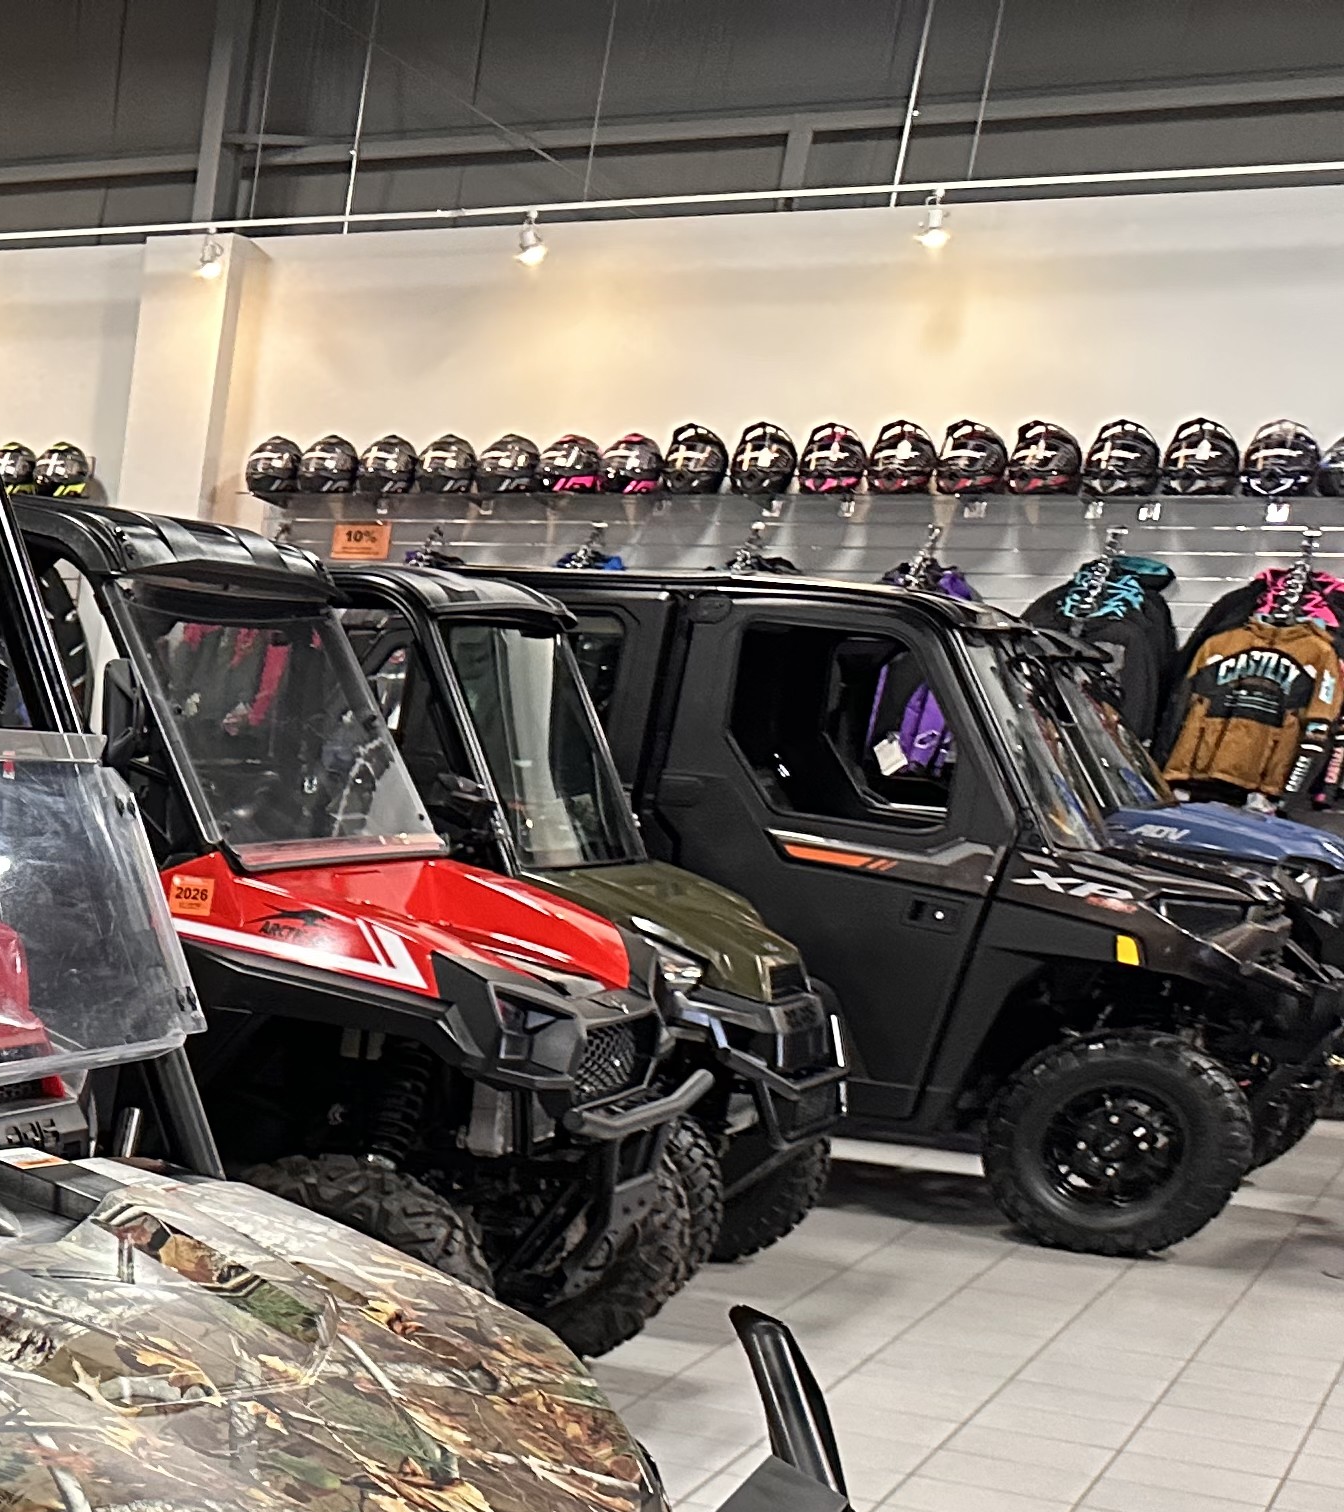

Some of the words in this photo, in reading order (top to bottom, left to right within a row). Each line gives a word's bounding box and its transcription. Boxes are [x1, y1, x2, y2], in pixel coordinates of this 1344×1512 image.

[345, 529, 378, 544] 10%
[1010, 868, 1134, 900] XP
[174, 886, 209, 902] 2026
